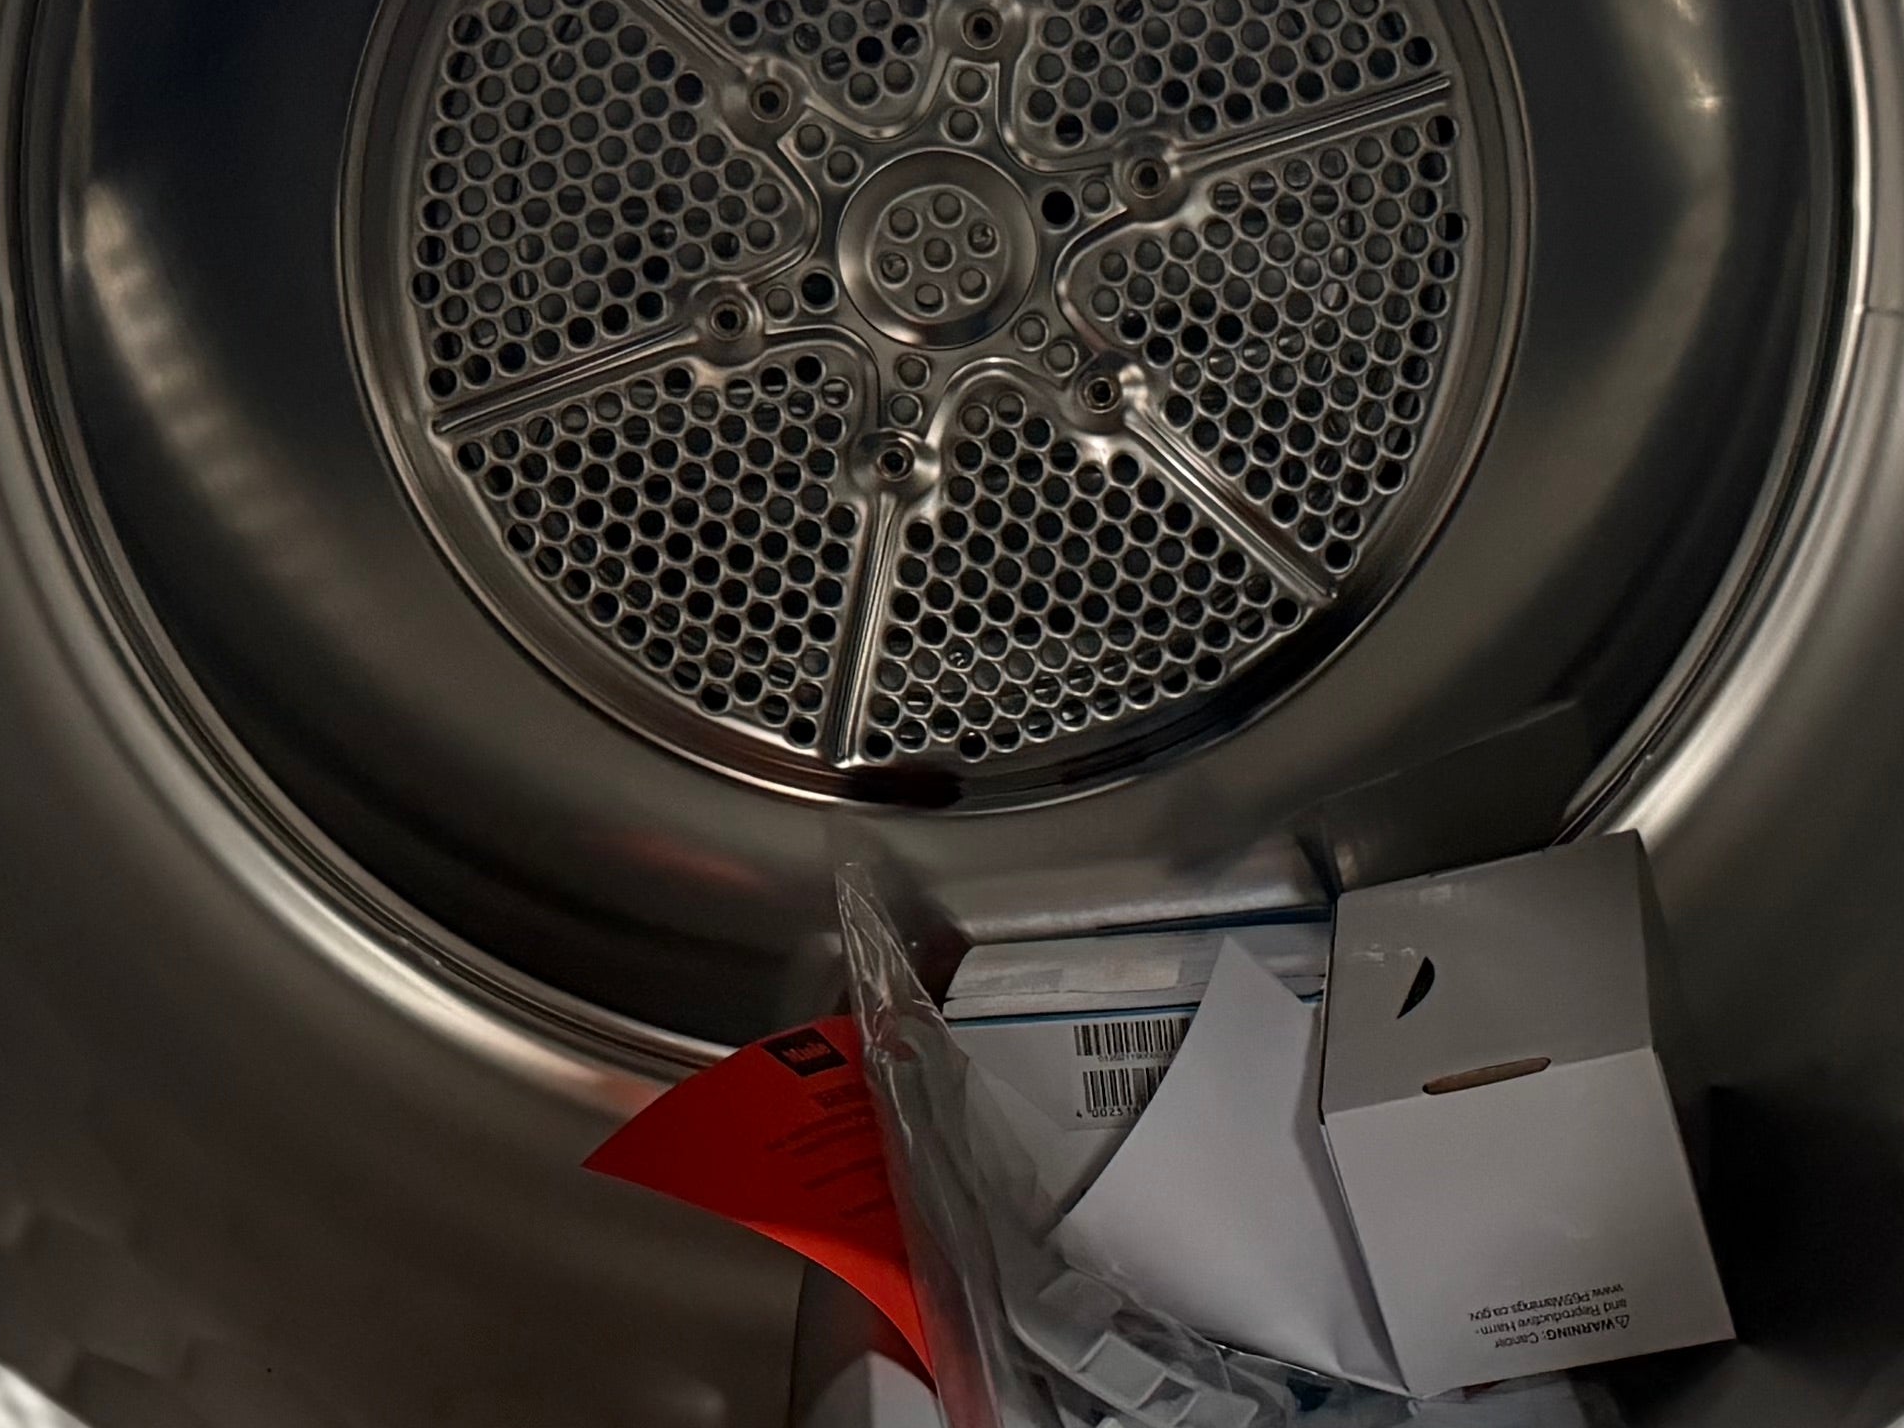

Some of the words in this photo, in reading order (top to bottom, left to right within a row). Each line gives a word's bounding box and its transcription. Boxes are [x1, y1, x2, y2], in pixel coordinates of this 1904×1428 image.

[1603, 1298, 1627, 1313] and
[1517, 1303, 1602, 1329] Reproductive
[1541, 1318, 1616, 1341] WARNING:
[1495, 1332, 1539, 1349] Cancer
